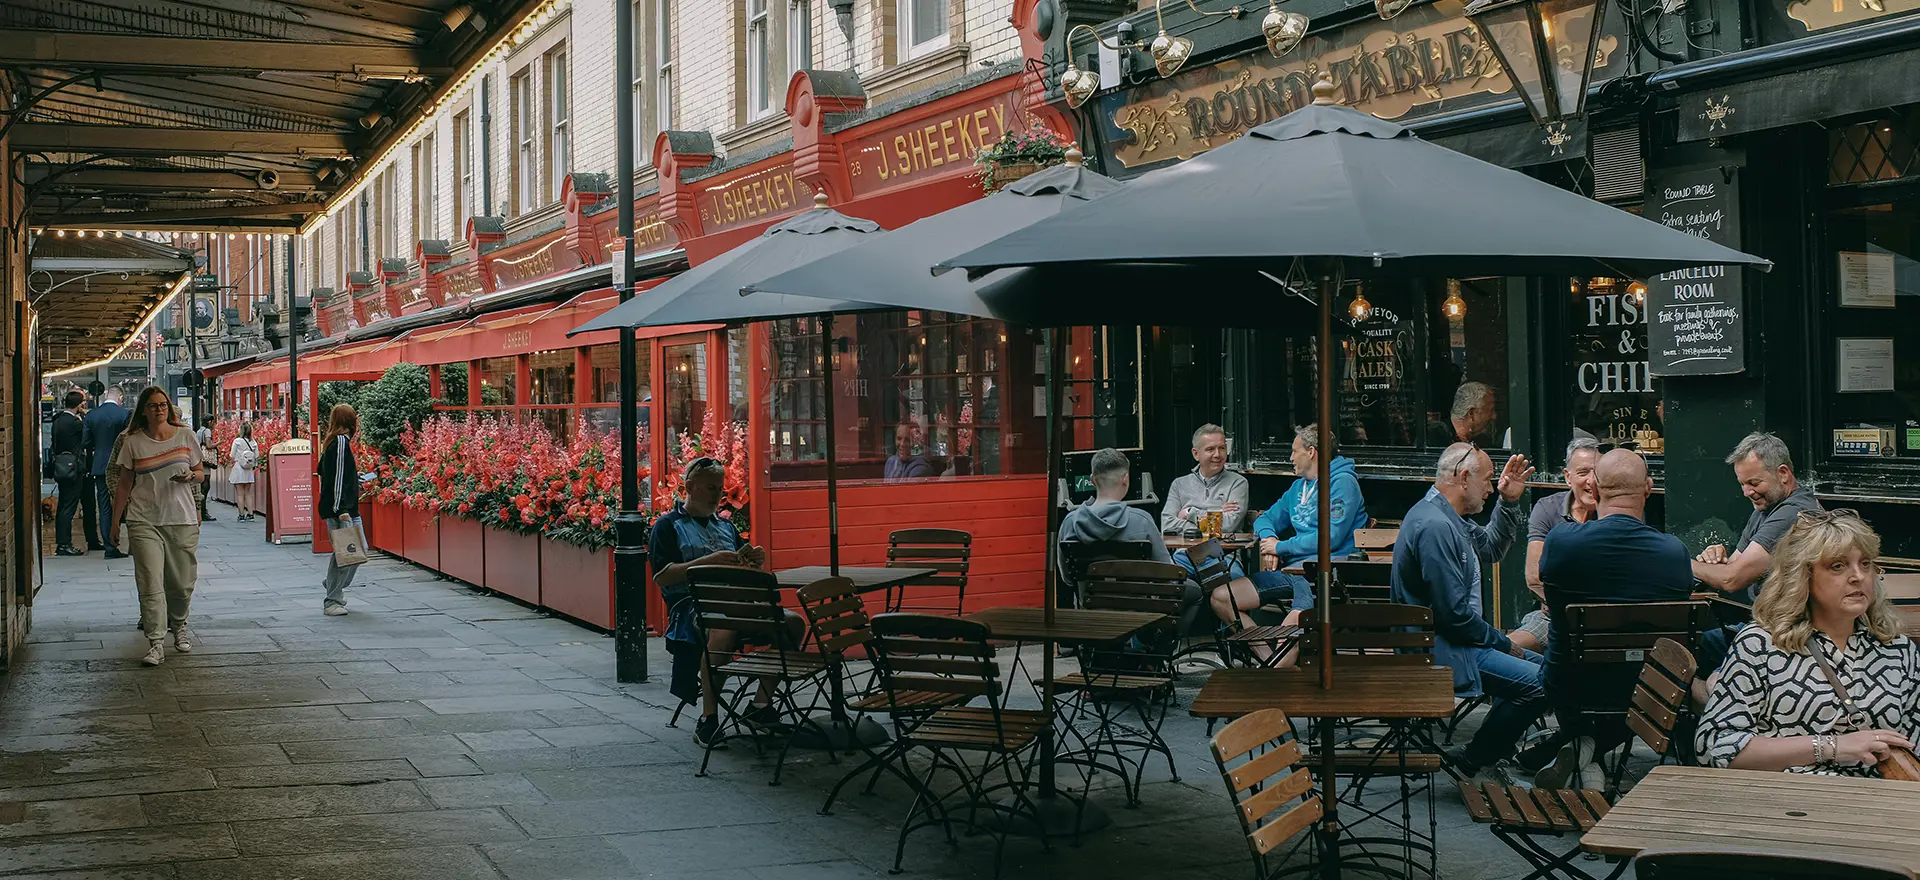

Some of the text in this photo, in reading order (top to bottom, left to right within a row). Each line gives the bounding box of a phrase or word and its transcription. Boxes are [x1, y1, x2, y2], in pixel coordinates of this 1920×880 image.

[1185, 26, 1481, 139] ROUND TABLE
[850, 161, 862, 176] 28
[877, 103, 1005, 180] J.SHEEKEY
[713, 171, 797, 225] J.SHEEKEY
[1692, 183, 1715, 195] TABLE
[1686, 209, 1725, 231] seating
[1674, 282, 1715, 301] ROOM
[1351, 307, 1399, 328] PURVEYOR
[1357, 340, 1394, 358] CASK
[1618, 329, 1636, 354] &
[1358, 361, 1393, 378] ALES
[1608, 422, 1651, 440] 1860
